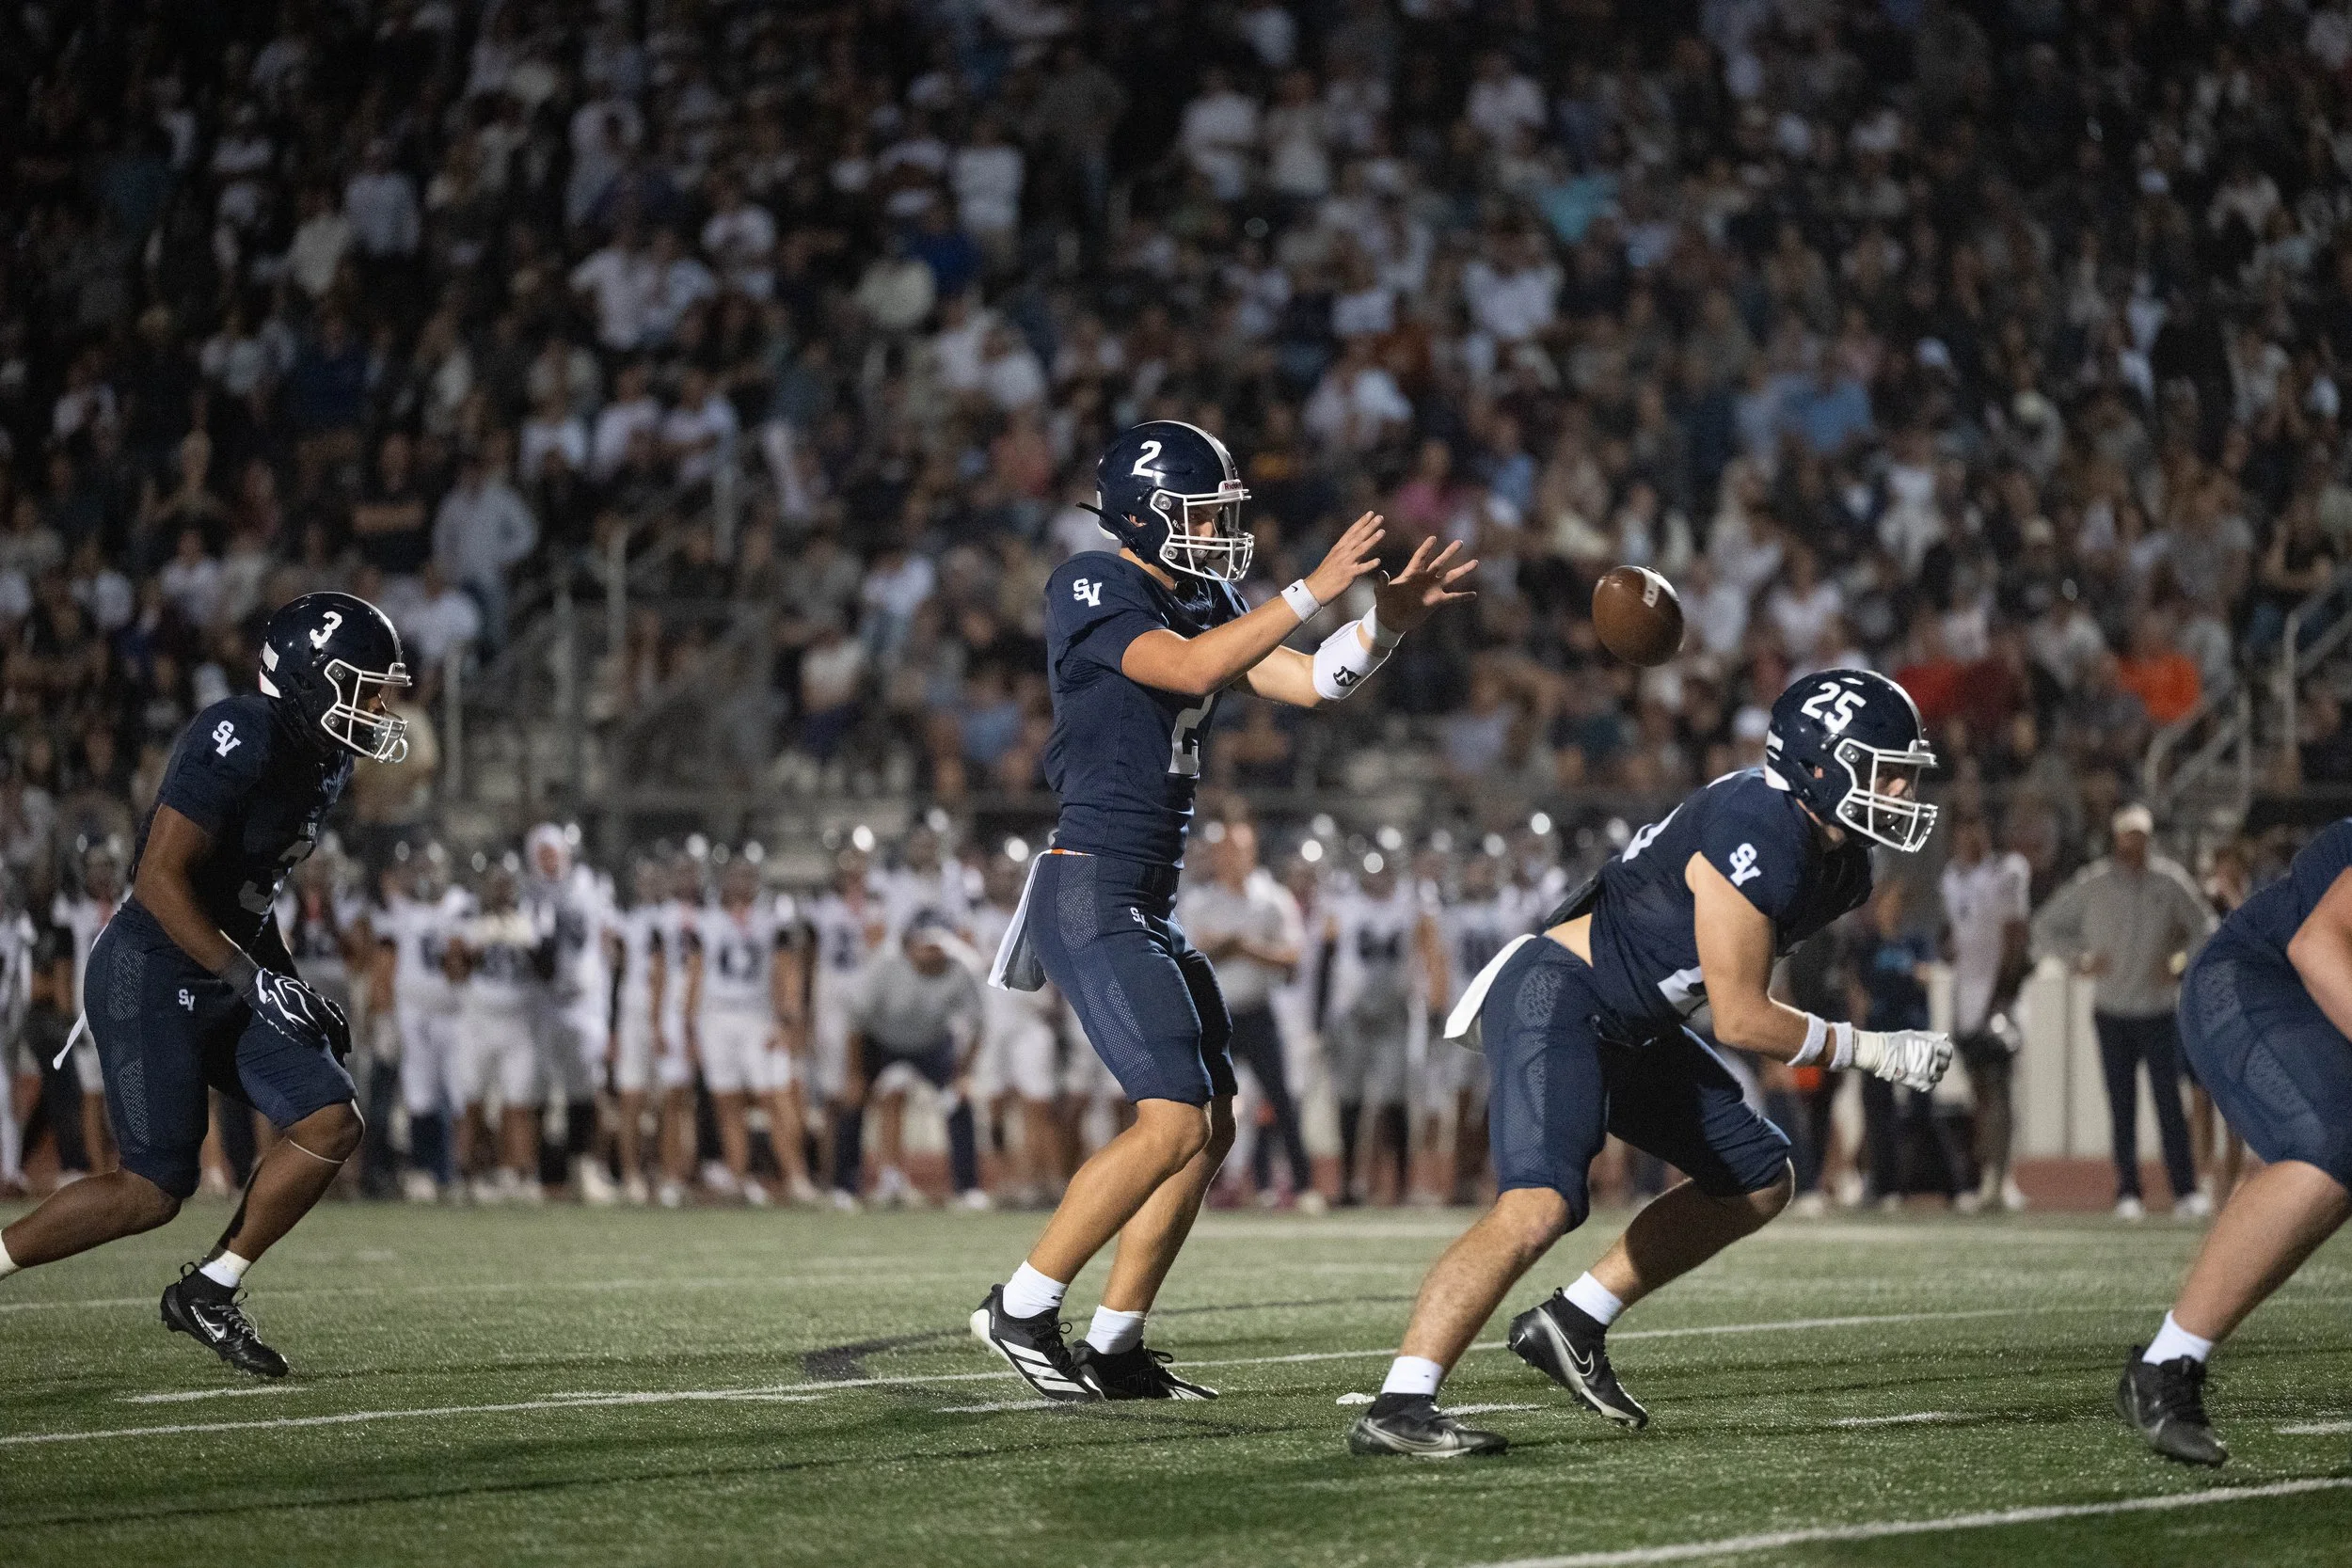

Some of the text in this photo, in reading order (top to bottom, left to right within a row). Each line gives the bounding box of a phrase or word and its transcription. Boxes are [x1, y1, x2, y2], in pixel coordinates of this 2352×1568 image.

[1132, 440, 1163, 478] 2
[1073, 578, 1103, 608] SV
[309, 610, 343, 646] 3
[1800, 681, 1867, 734] 25
[212, 720, 242, 757] SV
[1729, 843, 1762, 887] SV
[178, 989, 196, 1011] SV
